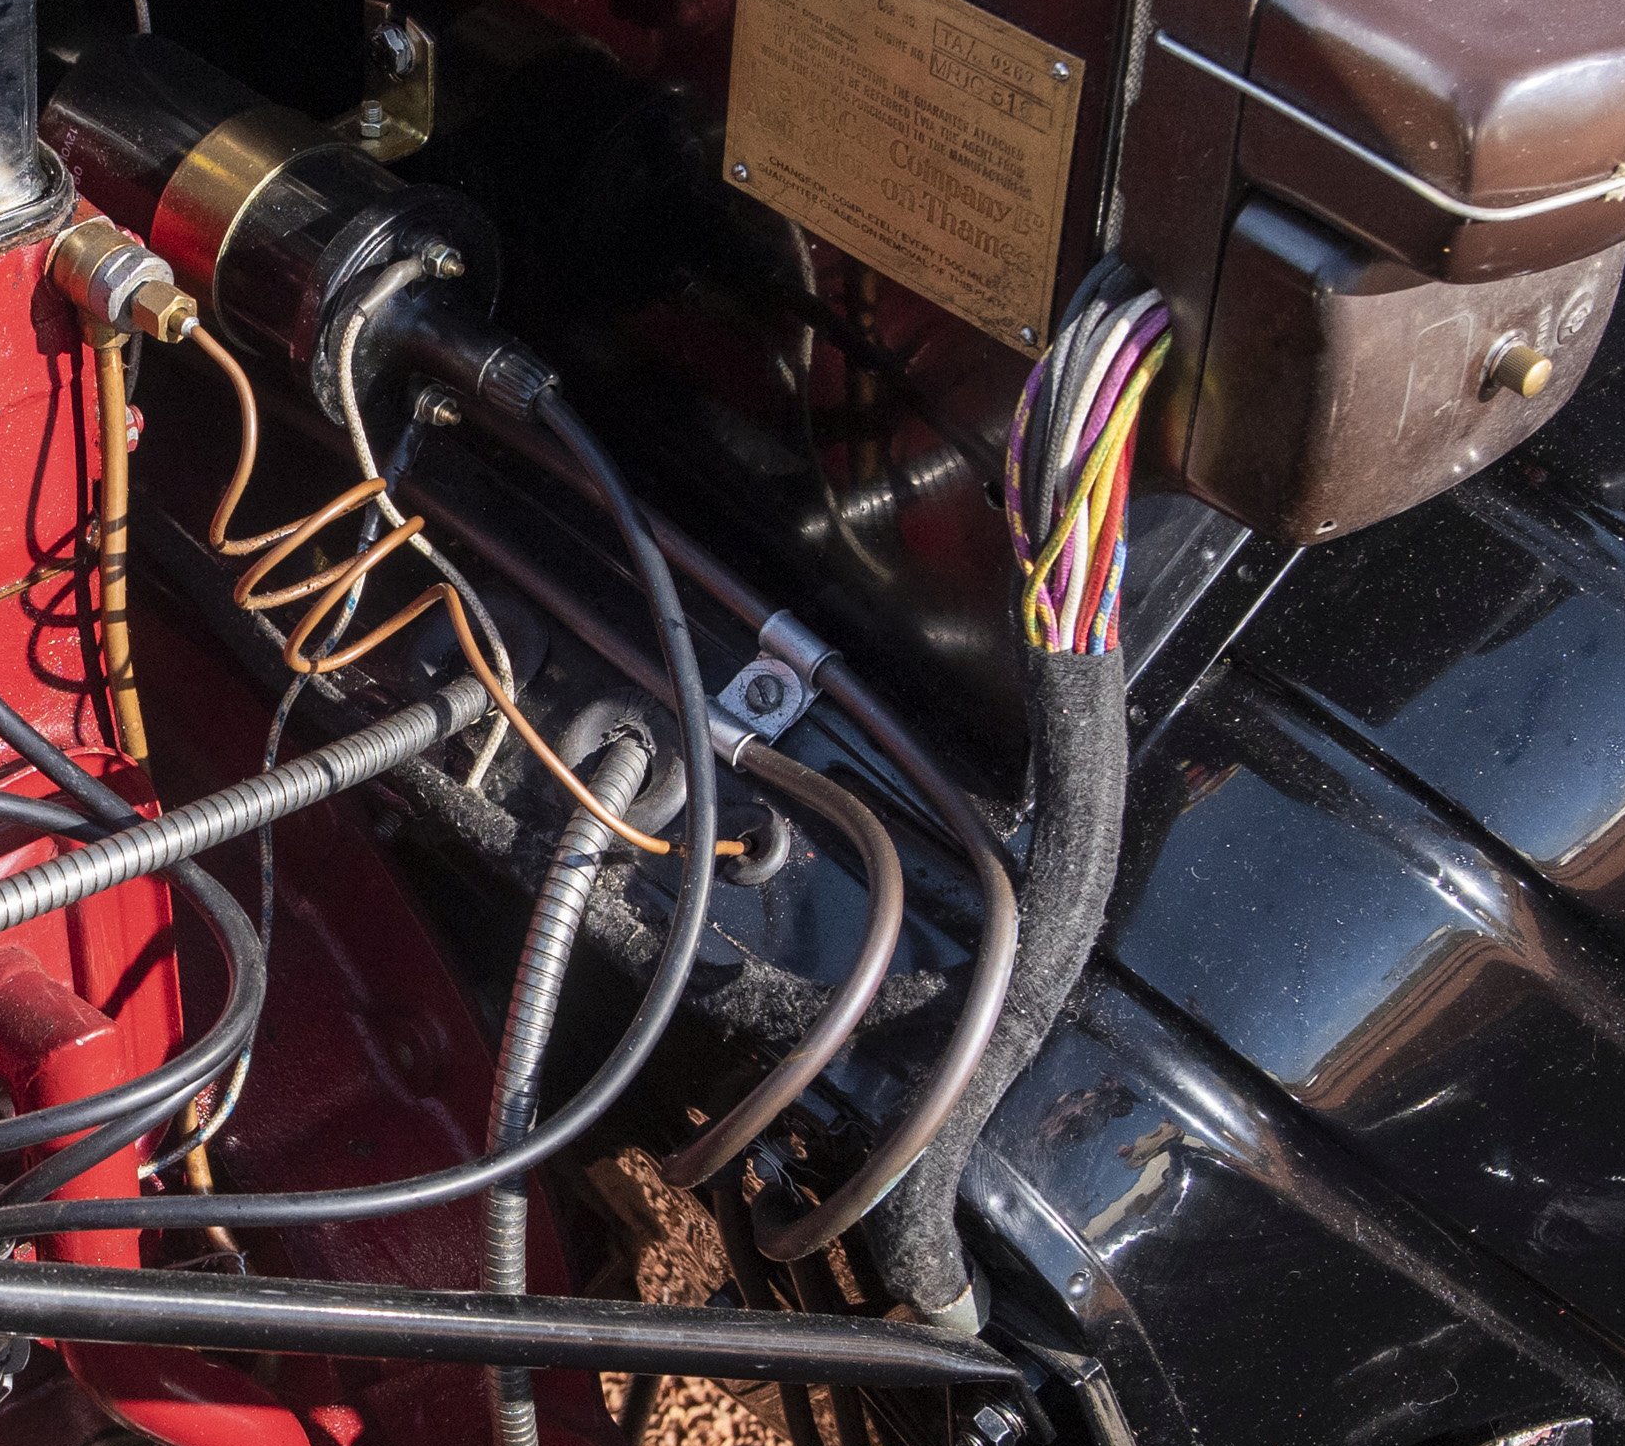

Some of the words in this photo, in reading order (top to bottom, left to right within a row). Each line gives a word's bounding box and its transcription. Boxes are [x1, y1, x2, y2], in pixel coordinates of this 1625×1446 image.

[768, 155, 811, 185] CHANGE
[831, 193, 900, 235] COMPLETELY
[900, 231, 936, 257] EVERY
[886, 141, 1013, 229] Company
